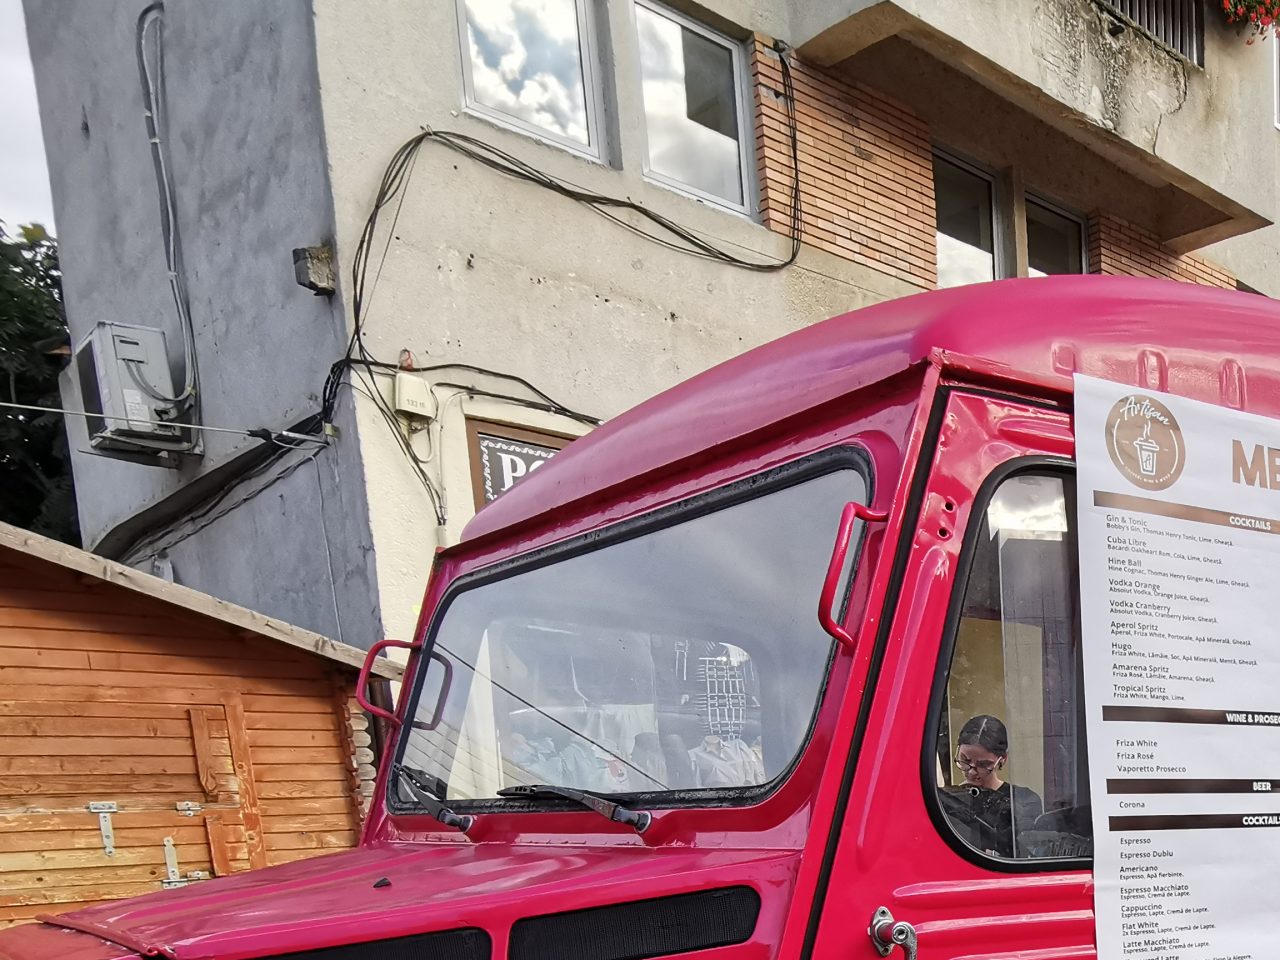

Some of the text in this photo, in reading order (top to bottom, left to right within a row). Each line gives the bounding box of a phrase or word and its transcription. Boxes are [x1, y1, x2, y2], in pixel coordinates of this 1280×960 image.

[1120, 396, 1169, 425] Artisan
[497, 452, 545, 491] P
[1107, 514, 1119, 523] Gin
[1128, 518, 1147, 527] Tonic
[1230, 516, 1270, 530] COCKTAILS
[1108, 536, 1146, 548] Cuba Libre
[1109, 557, 1126, 565] Hine
[1109, 578, 1160, 592] Vodka Orange
[1110, 600, 1171, 614] Vodka Cranberry
[1111, 621, 1158, 632] Aperol Spritz
[1112, 642, 1132, 651] Hugo
[1113, 663, 1169, 674] Amarena Spritz
[1114, 684, 1166, 694] Tropical Spritz
[1226, 714, 1246, 722] WINE
[1121, 904, 1162, 913] Cappuccino
[1144, 938, 1179, 946] Macchiato
